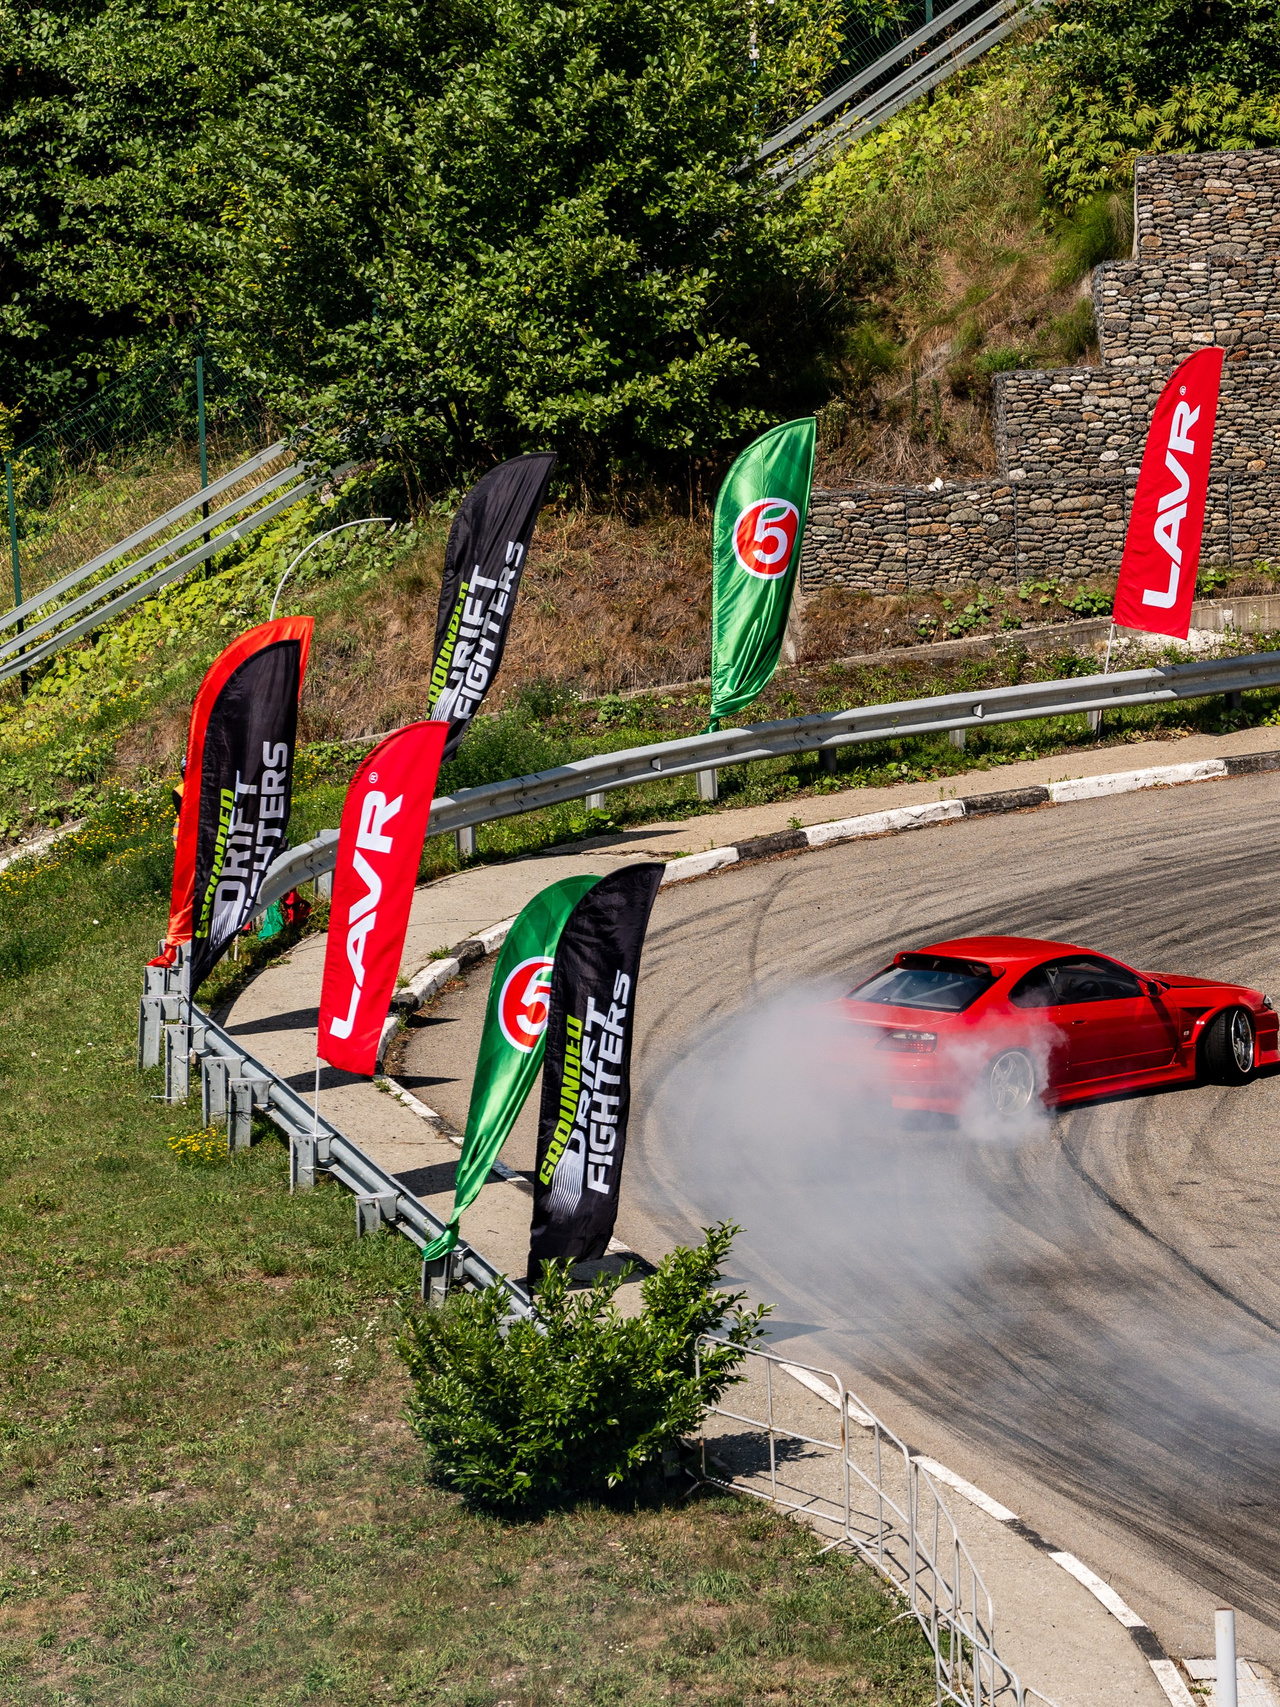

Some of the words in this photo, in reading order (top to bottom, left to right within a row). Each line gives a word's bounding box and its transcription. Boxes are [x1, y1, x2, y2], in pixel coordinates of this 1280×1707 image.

[1142, 400, 1201, 609] LAVR
[453, 540, 525, 720] FIGHTERS
[211, 770, 258, 932] DRIFT
[329, 789, 403, 1040] LAVR
[539, 1014, 583, 1186] GROUNDED
[556, 996, 607, 1192] DRIFT
[587, 969, 632, 1195] FIGHTERS
